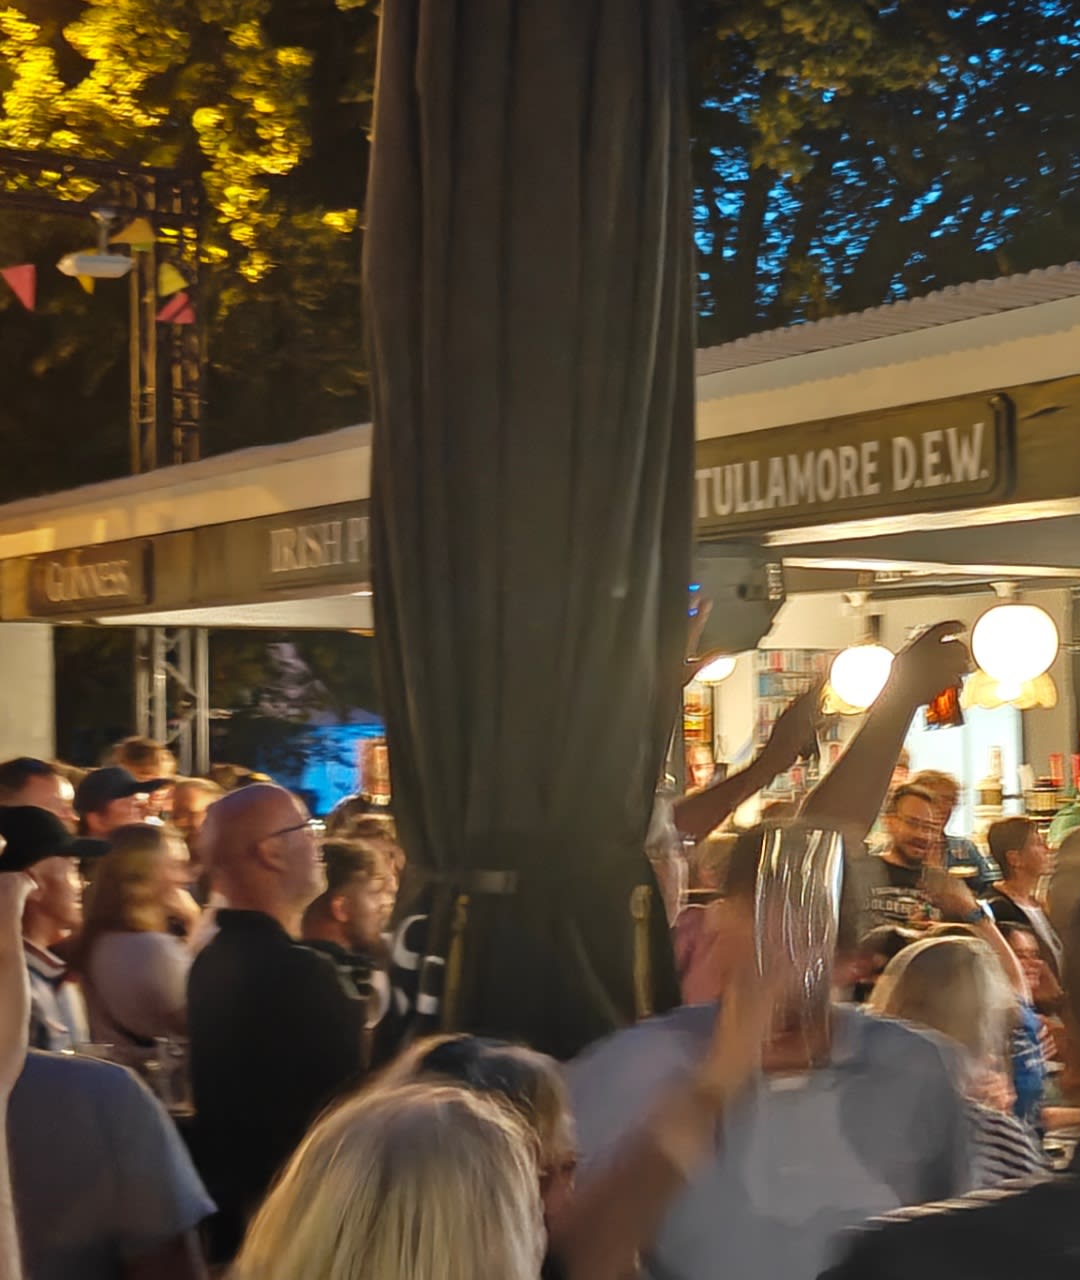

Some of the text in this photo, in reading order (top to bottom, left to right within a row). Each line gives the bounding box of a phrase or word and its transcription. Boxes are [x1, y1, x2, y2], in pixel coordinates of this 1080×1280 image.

[695, 422, 990, 519] TULLAMORE D.E.W.
[270, 520, 344, 573] IRISH
